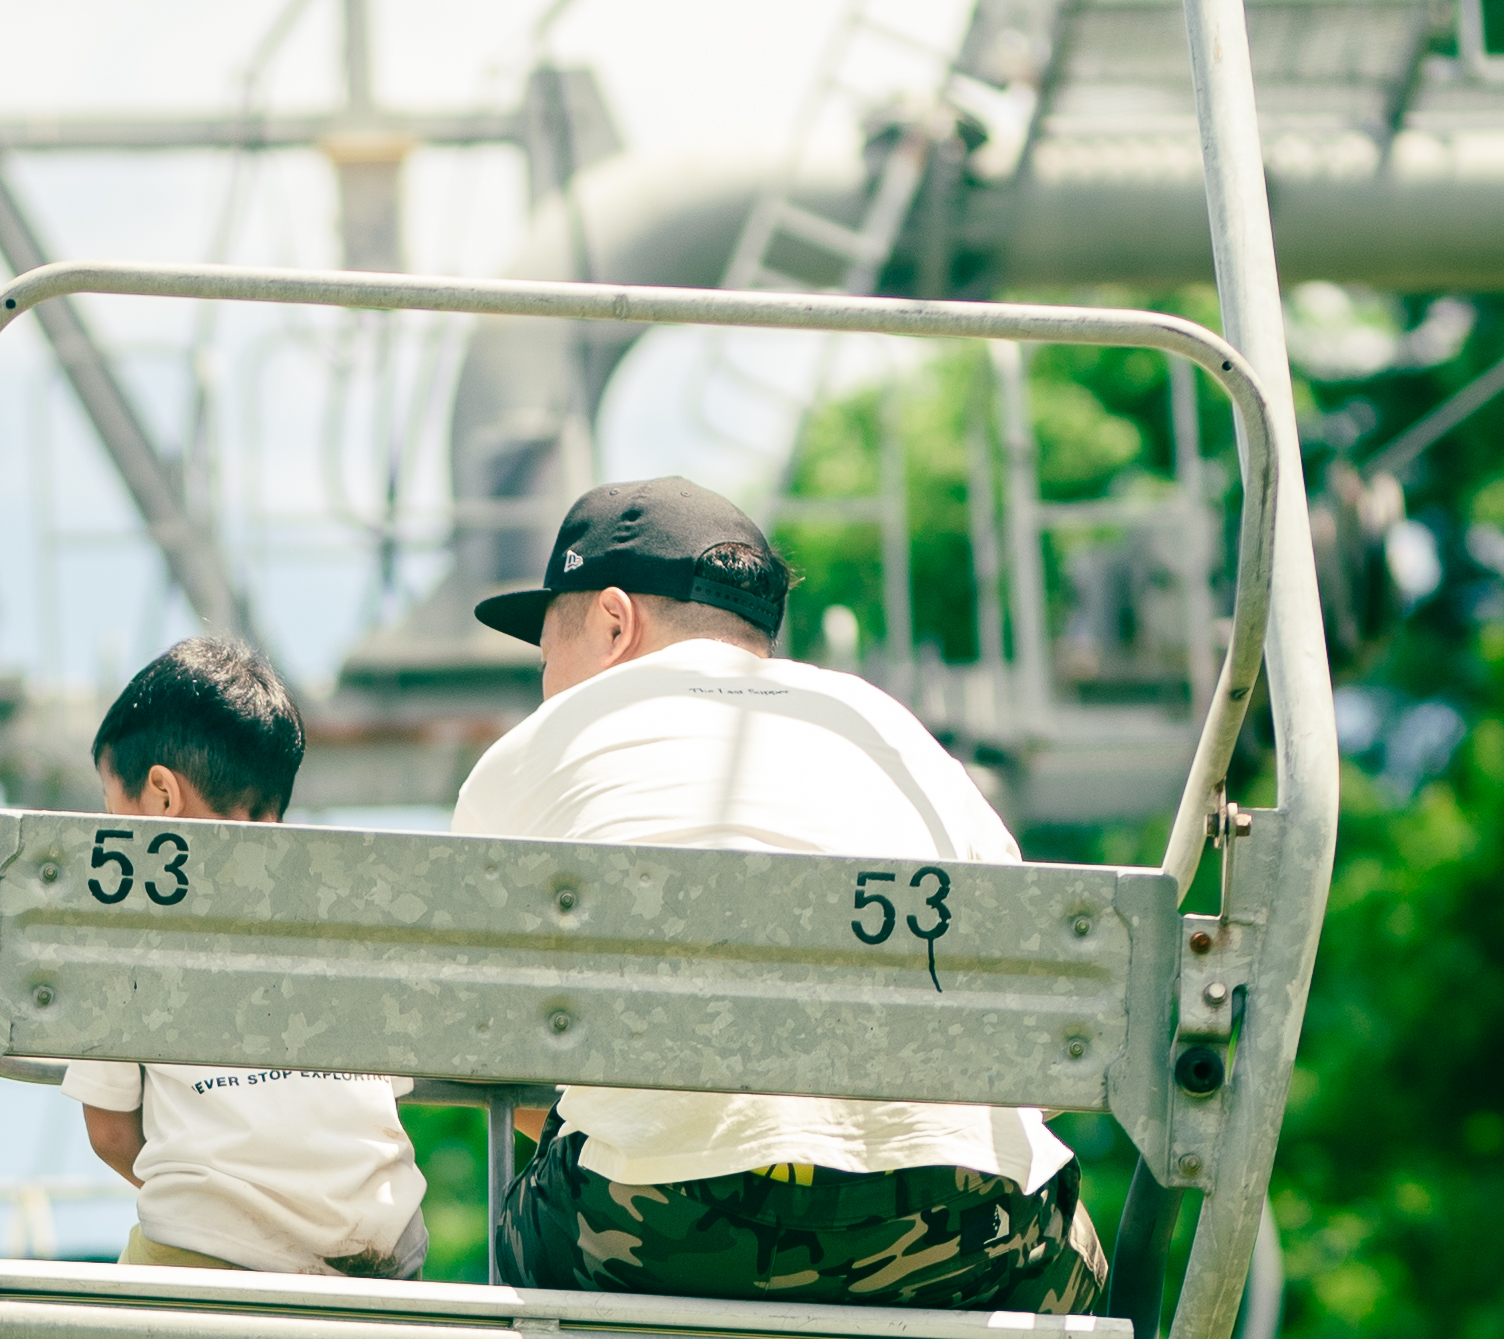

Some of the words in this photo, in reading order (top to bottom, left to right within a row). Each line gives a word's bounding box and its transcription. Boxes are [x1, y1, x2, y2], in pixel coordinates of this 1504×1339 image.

[88, 829, 189, 906] 53
[851, 866, 952, 945] 53
[191, 1075, 240, 1095] EVER
[247, 1069, 292, 1085] STOP
